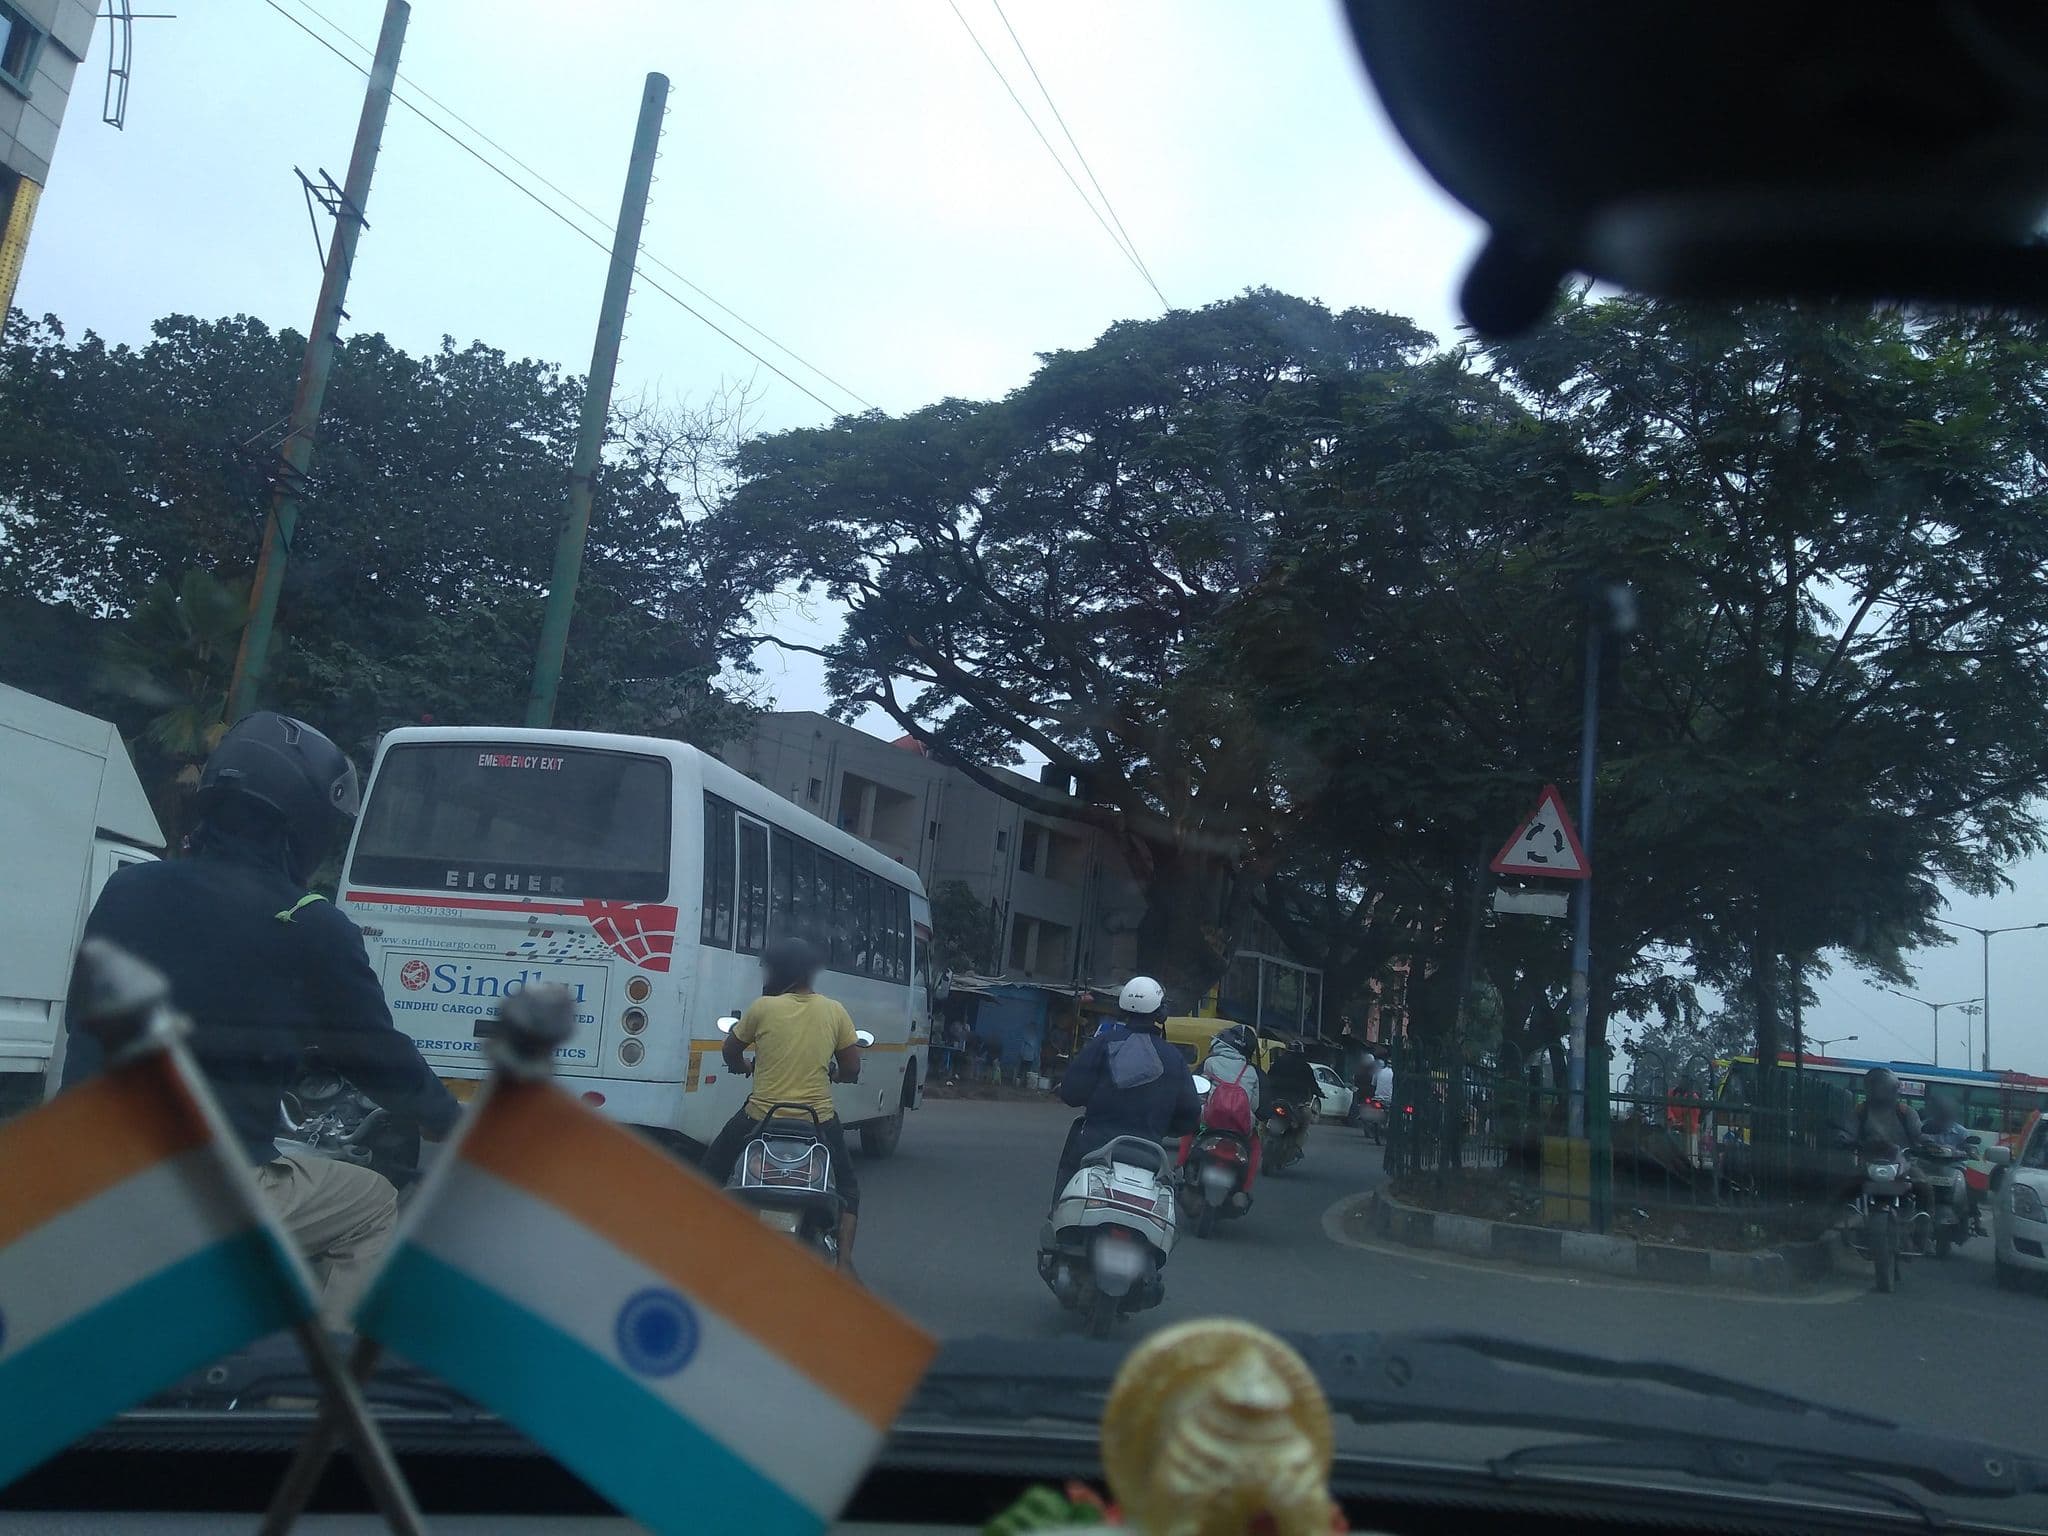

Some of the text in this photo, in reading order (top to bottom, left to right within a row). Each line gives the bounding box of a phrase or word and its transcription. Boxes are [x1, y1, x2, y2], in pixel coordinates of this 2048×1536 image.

[478, 754, 564, 771] EMERGENCY EXIT
[445, 870, 565, 893] EICHER
[373, 936, 497, 951] www.sindhucargo.com
[432, 963, 587, 1004] Sindu
[393, 1000, 438, 1012] SINDHU
[442, 1003, 483, 1015] CARGO
